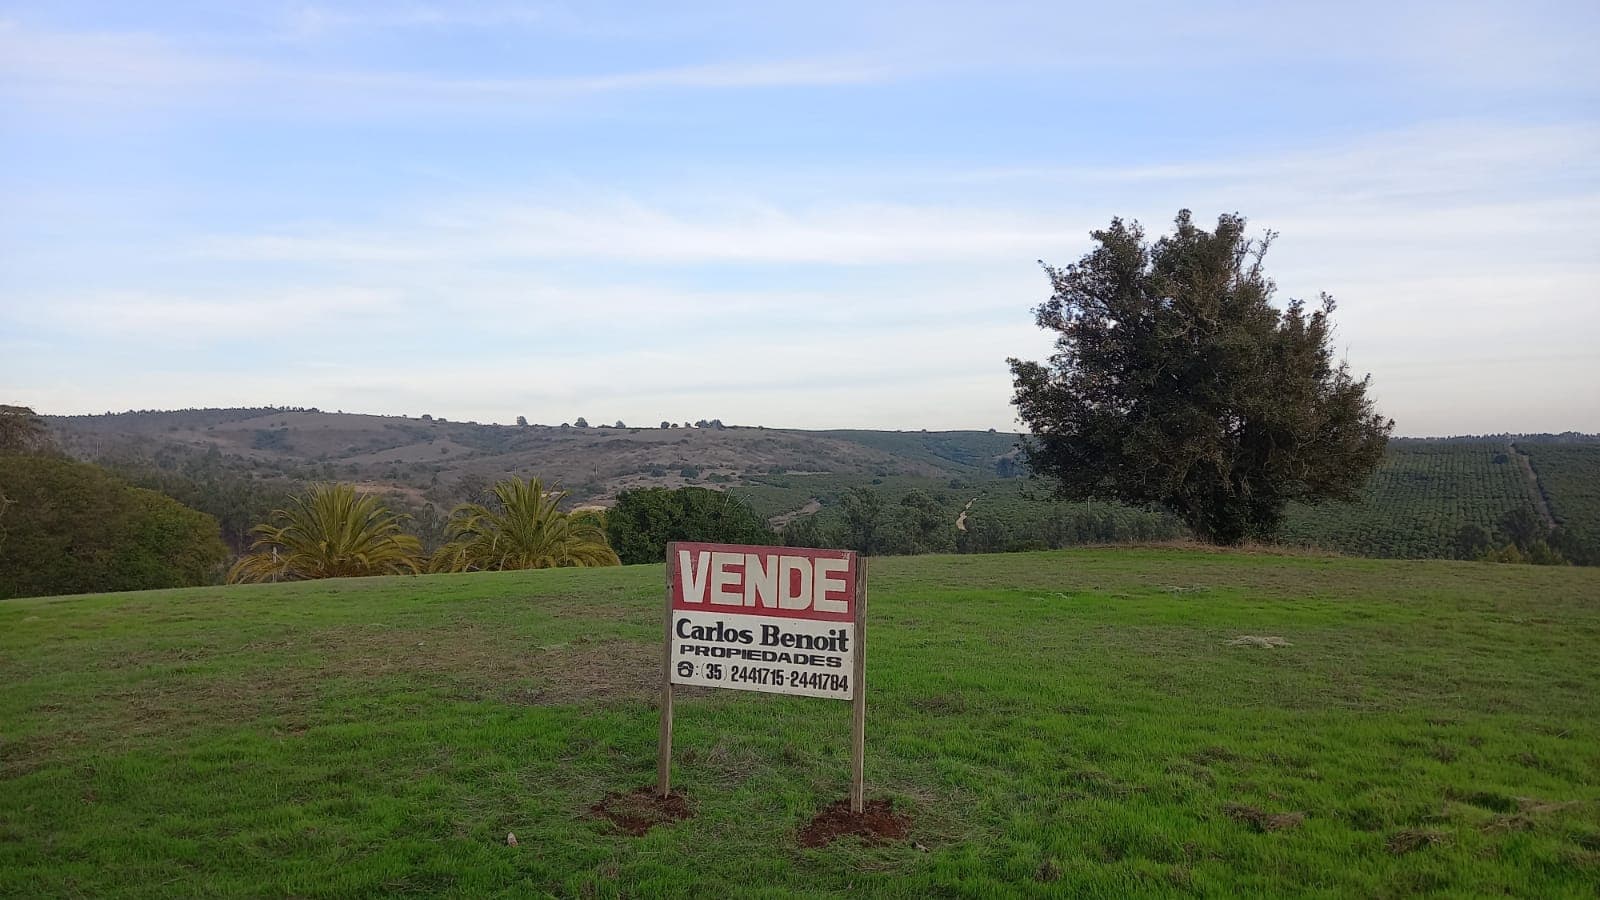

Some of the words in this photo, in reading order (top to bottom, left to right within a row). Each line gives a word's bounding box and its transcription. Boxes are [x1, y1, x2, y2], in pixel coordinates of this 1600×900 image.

[678, 550, 849, 613] VENDE
[676, 618, 753, 644] Carlos
[759, 624, 849, 652] Benoit
[680, 644, 842, 668] PROPIEDADES
